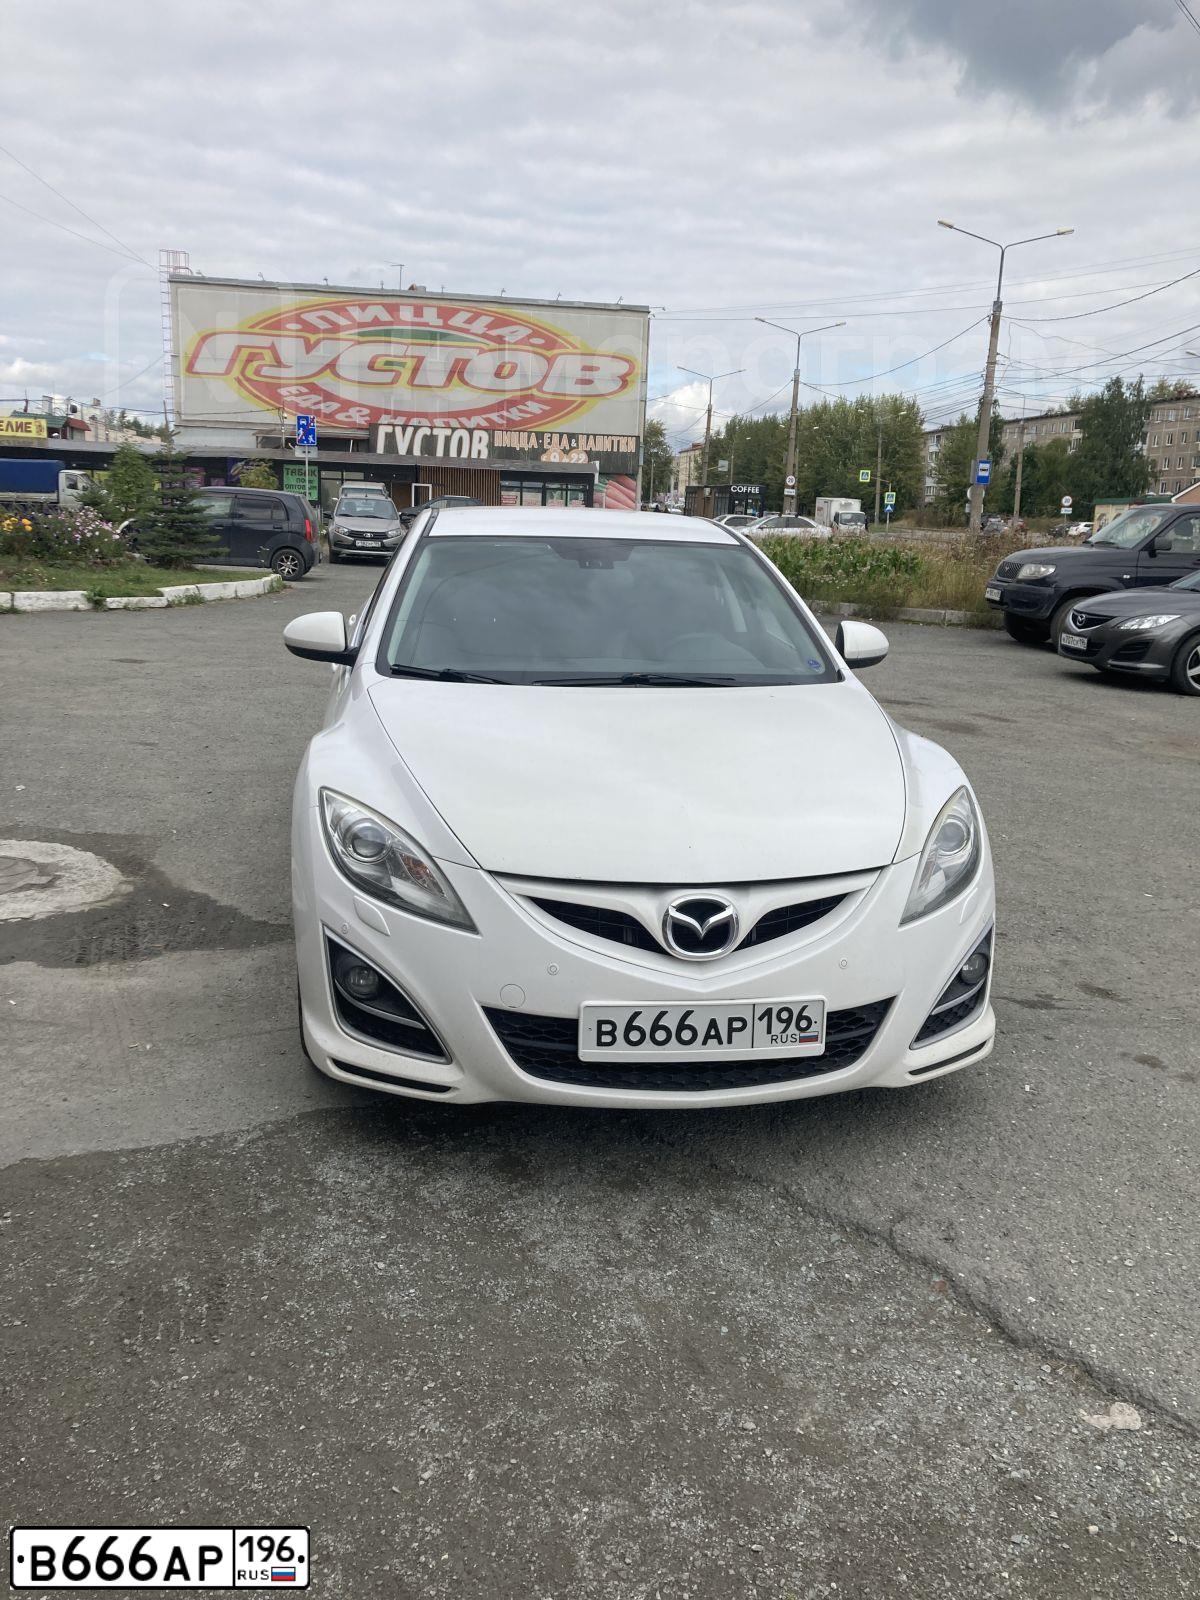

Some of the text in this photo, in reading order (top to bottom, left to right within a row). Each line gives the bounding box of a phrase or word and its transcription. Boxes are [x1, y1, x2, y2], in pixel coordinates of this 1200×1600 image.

[309, 305, 524, 345] ПИЦЦА
[187, 331, 635, 398] ГУСТОВ
[277, 386, 341, 413] ЕДА
[378, 400, 552, 428] НАПИТКИ
[376, 425, 489, 459] ГУСТОВ
[494, 431, 538, 451] ПИЦЦА
[543, 432, 570, 450] ЕДА
[578, 434, 636, 453] НАПИТКИ
[731, 485, 760, 494] COFFEE
[596, 1004, 813, 1047] В666АР 196
[770, 1033, 798, 1045] RUS
